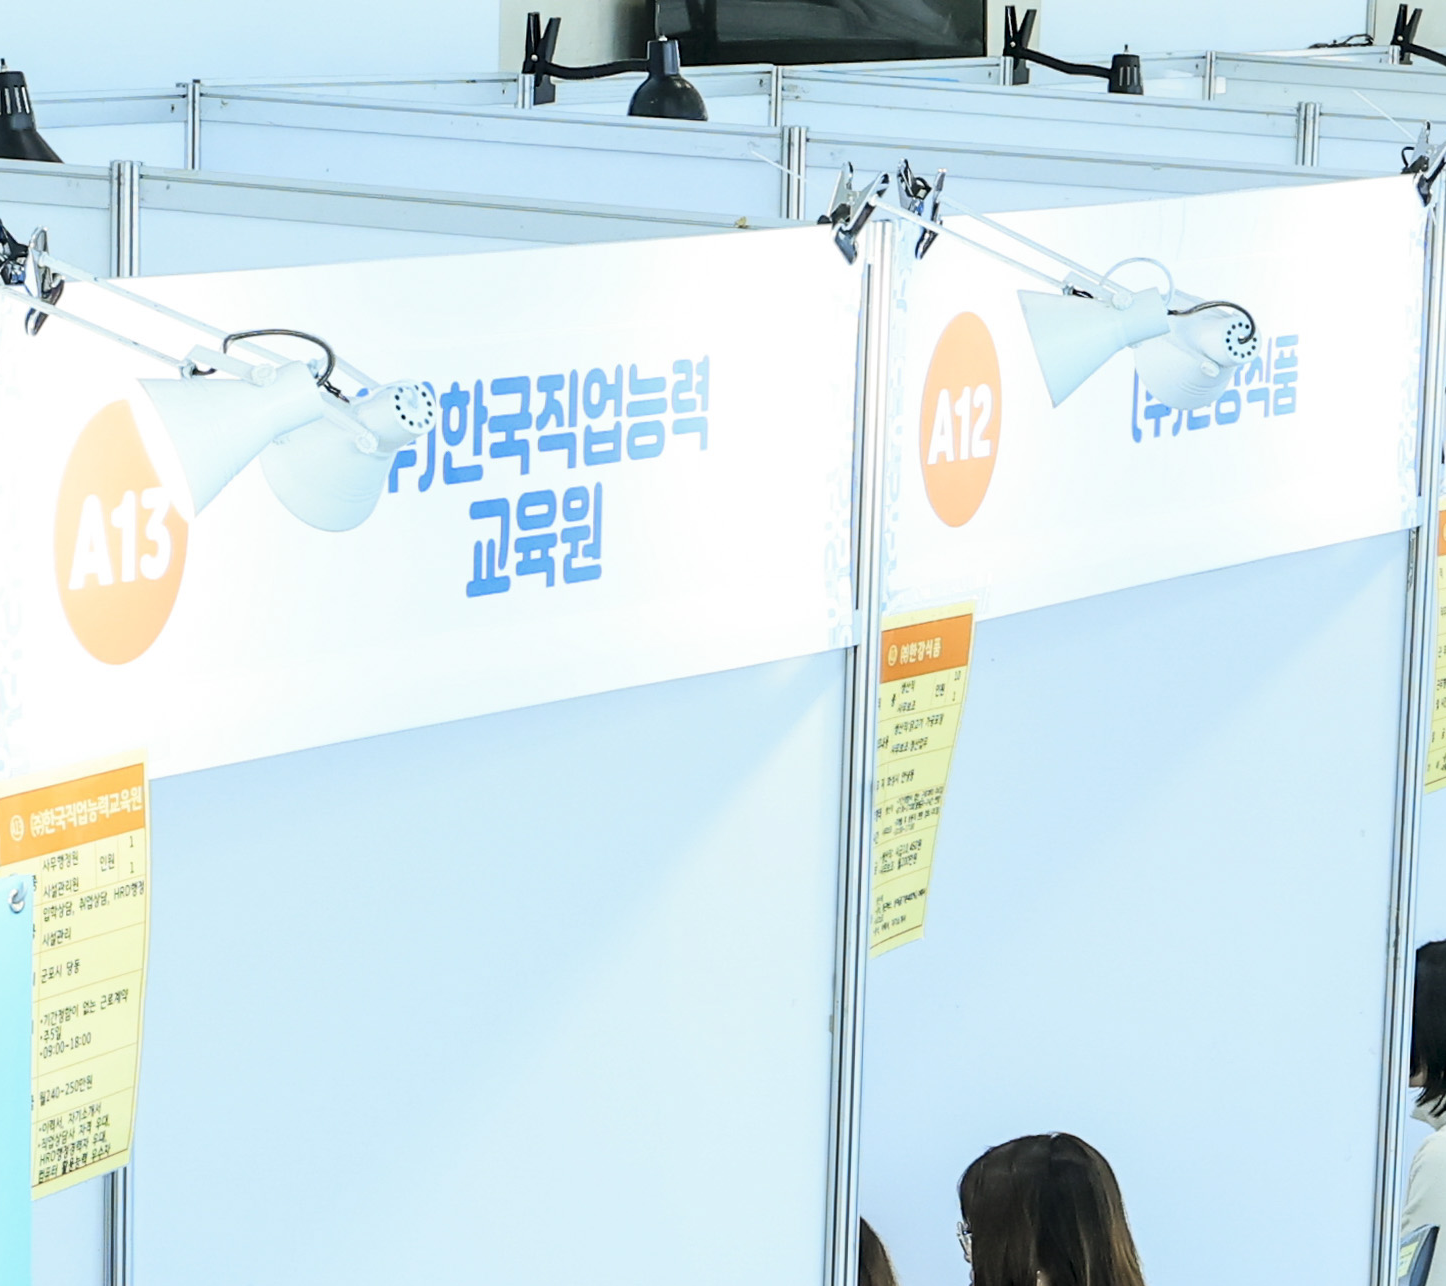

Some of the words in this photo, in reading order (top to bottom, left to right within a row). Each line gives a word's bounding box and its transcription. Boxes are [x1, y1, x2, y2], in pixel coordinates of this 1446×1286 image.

[927, 383, 992, 465] A12
[67, 486, 174, 592] A13
[466, 482, 602, 598] 교육원
